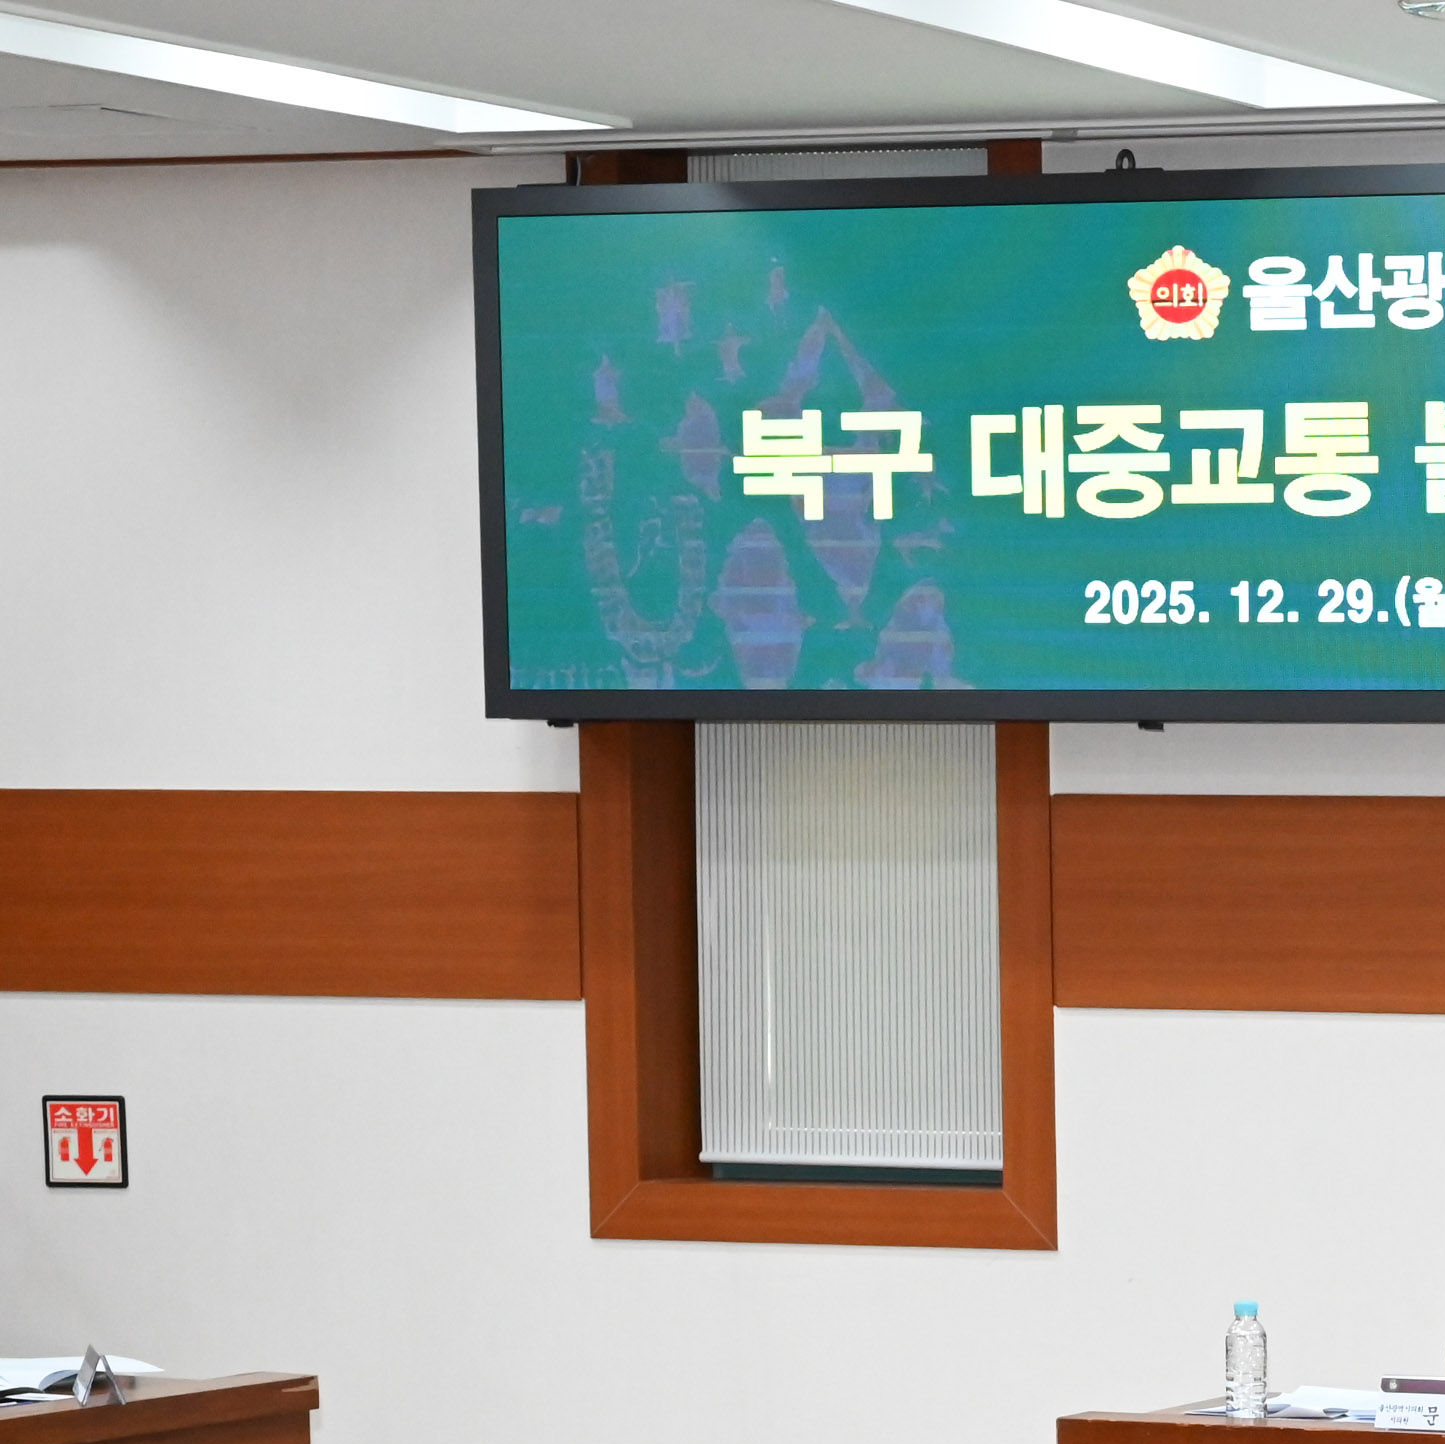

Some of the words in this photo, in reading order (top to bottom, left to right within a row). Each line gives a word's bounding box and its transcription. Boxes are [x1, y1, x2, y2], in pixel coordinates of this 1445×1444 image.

[1153, 282, 1204, 308] 의회
[732, 409, 933, 521] 북구
[971, 401, 1379, 519] 대중교통
[1084, 579, 1210, 625] 2025.
[1230, 579, 1299, 623] 12.
[54, 1106, 114, 1123] 소화기
